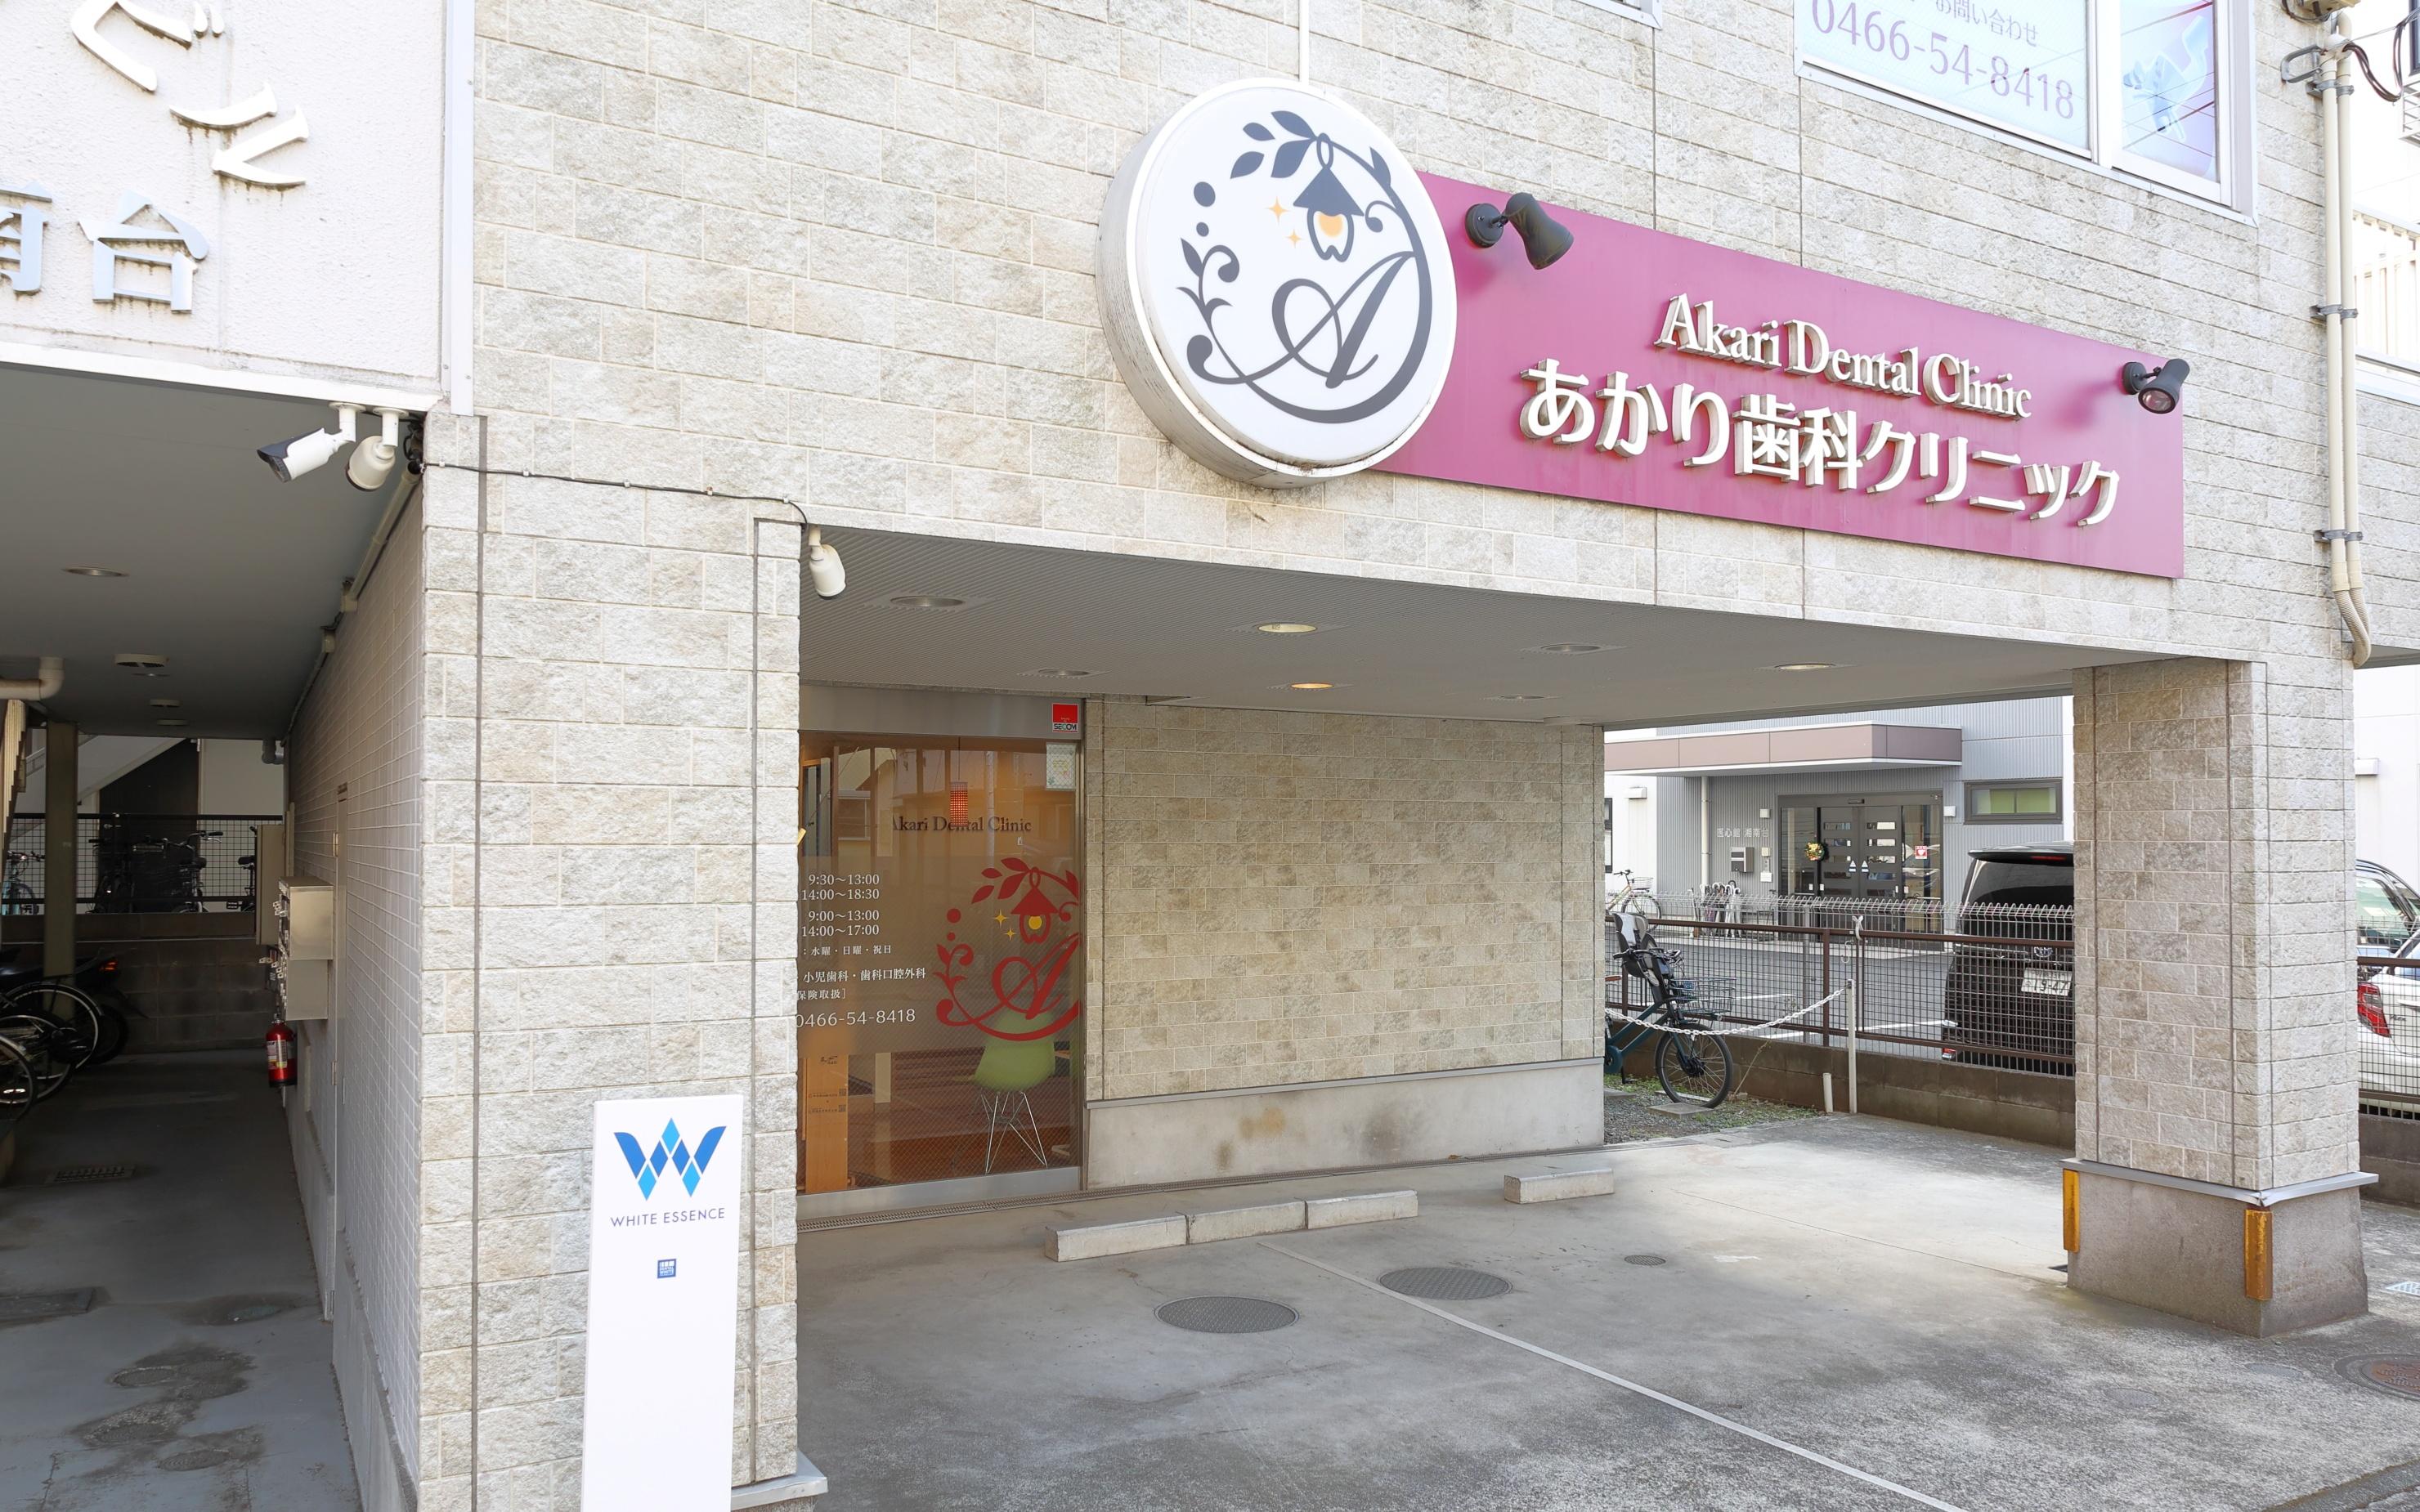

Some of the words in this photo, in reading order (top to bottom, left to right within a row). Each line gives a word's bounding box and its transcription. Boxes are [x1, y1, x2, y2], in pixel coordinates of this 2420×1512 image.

[1811, 0, 2074, 120] 0466-54-8418
[1654, 292, 1782, 370] Akari
[1784, 319, 1922, 398] Dental
[1923, 352, 2032, 419] Clinic
[1519, 356, 2121, 528] あかり歯科クリニック
[1053, 722, 1078, 731] SECOM
[987, 816, 1033, 831] Clinic
[796, 1009, 916, 1028] 0466-54-8418
[610, 1213, 658, 1227] WHITE
[663, 1207, 725, 1223] ESSENCE
